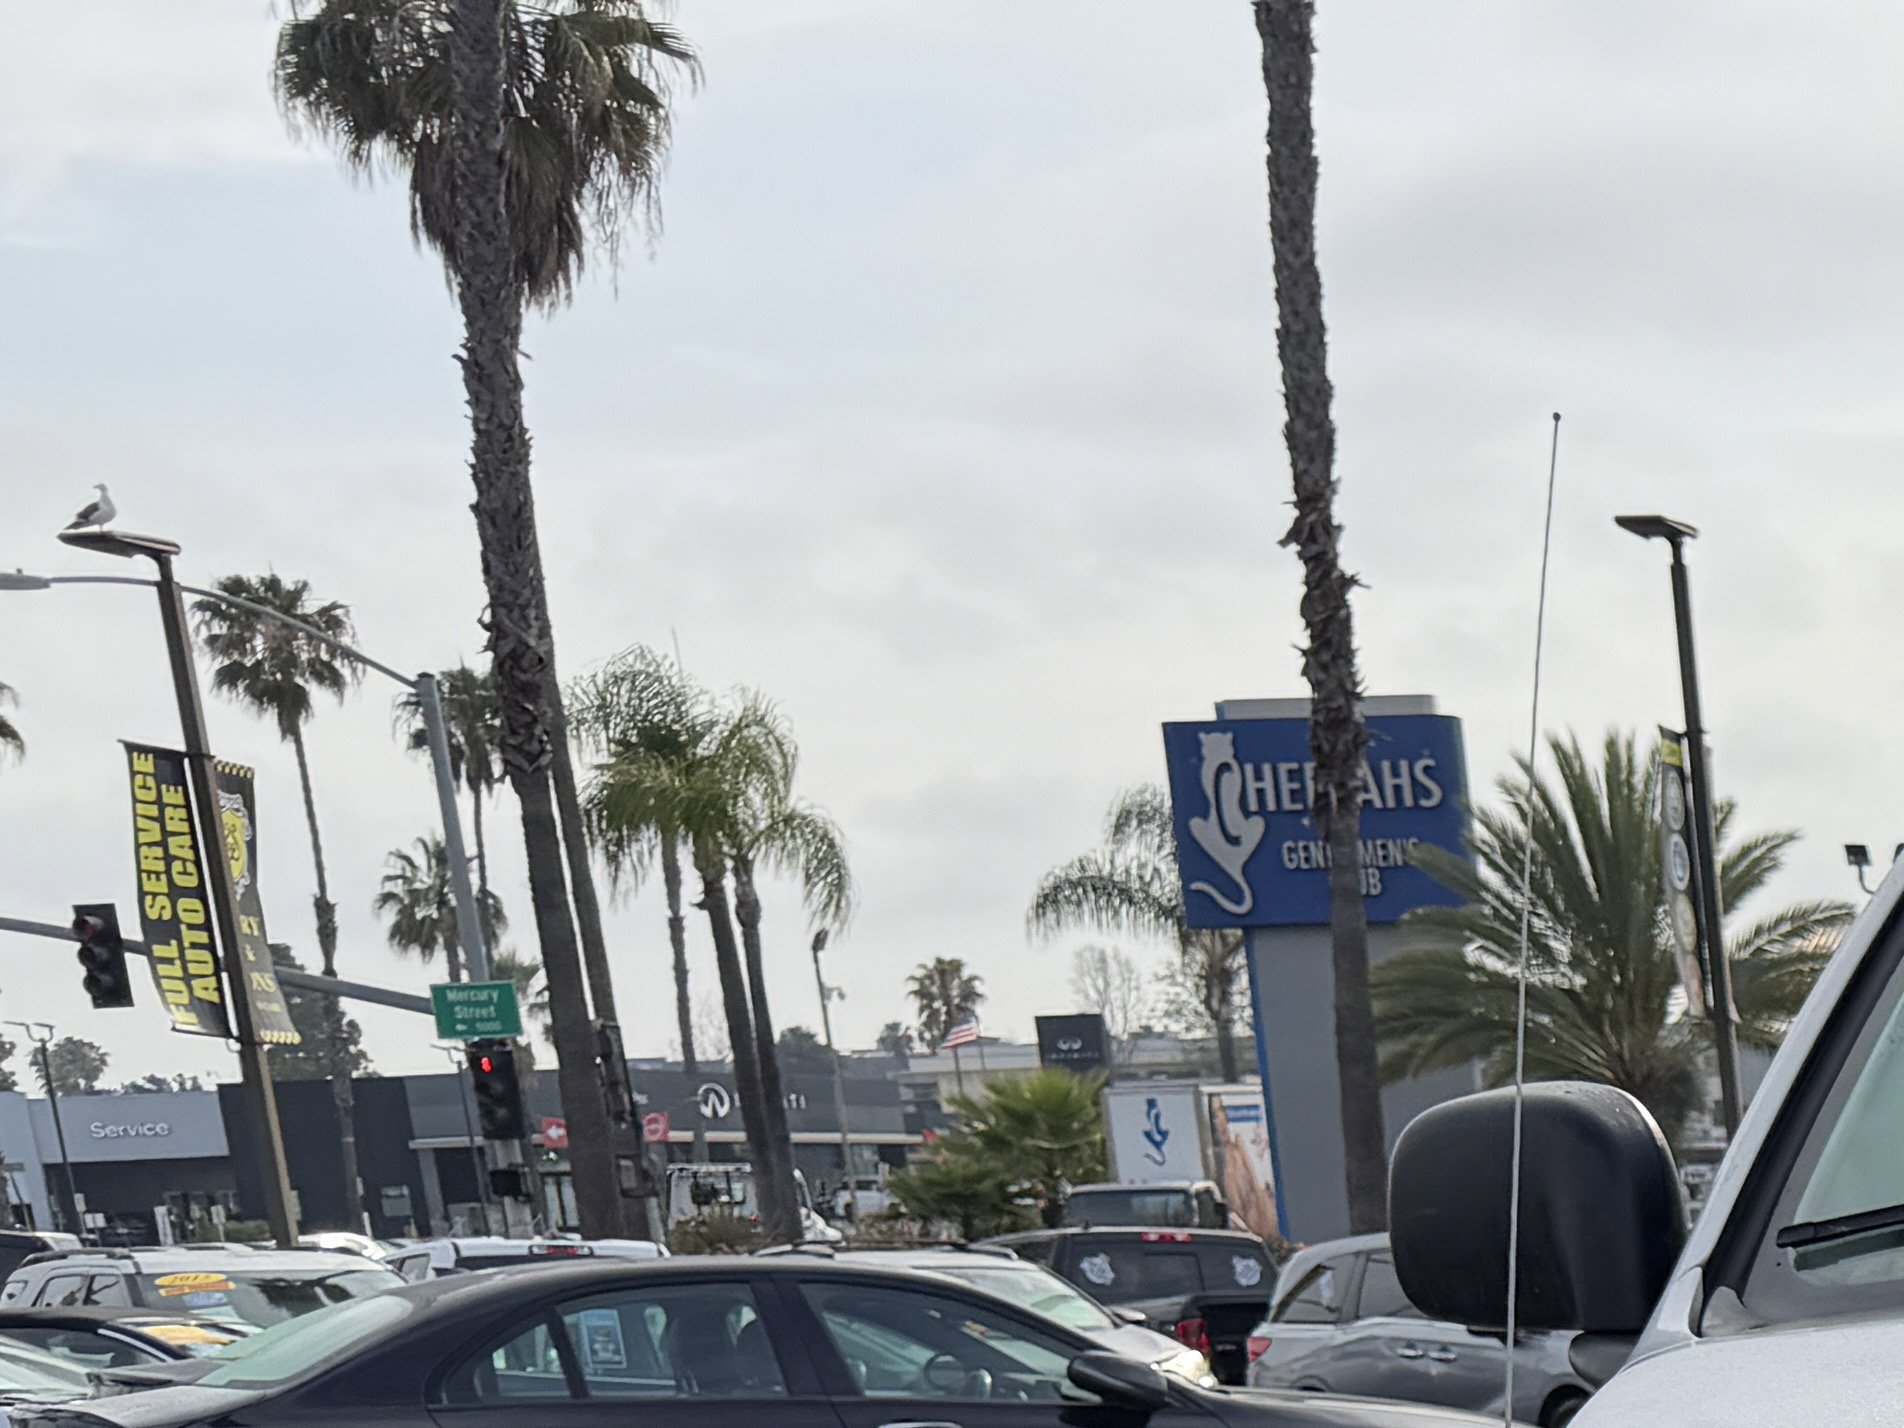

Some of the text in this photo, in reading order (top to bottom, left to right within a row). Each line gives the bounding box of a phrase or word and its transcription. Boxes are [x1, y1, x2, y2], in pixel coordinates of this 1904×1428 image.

[132, 751, 199, 1027] FULL SERVICE
[161, 783, 221, 1004] AUTO CARE
[446, 988, 499, 1004] Mercury
[454, 1005, 496, 1019] Street
[90, 1122, 171, 1138] Service
